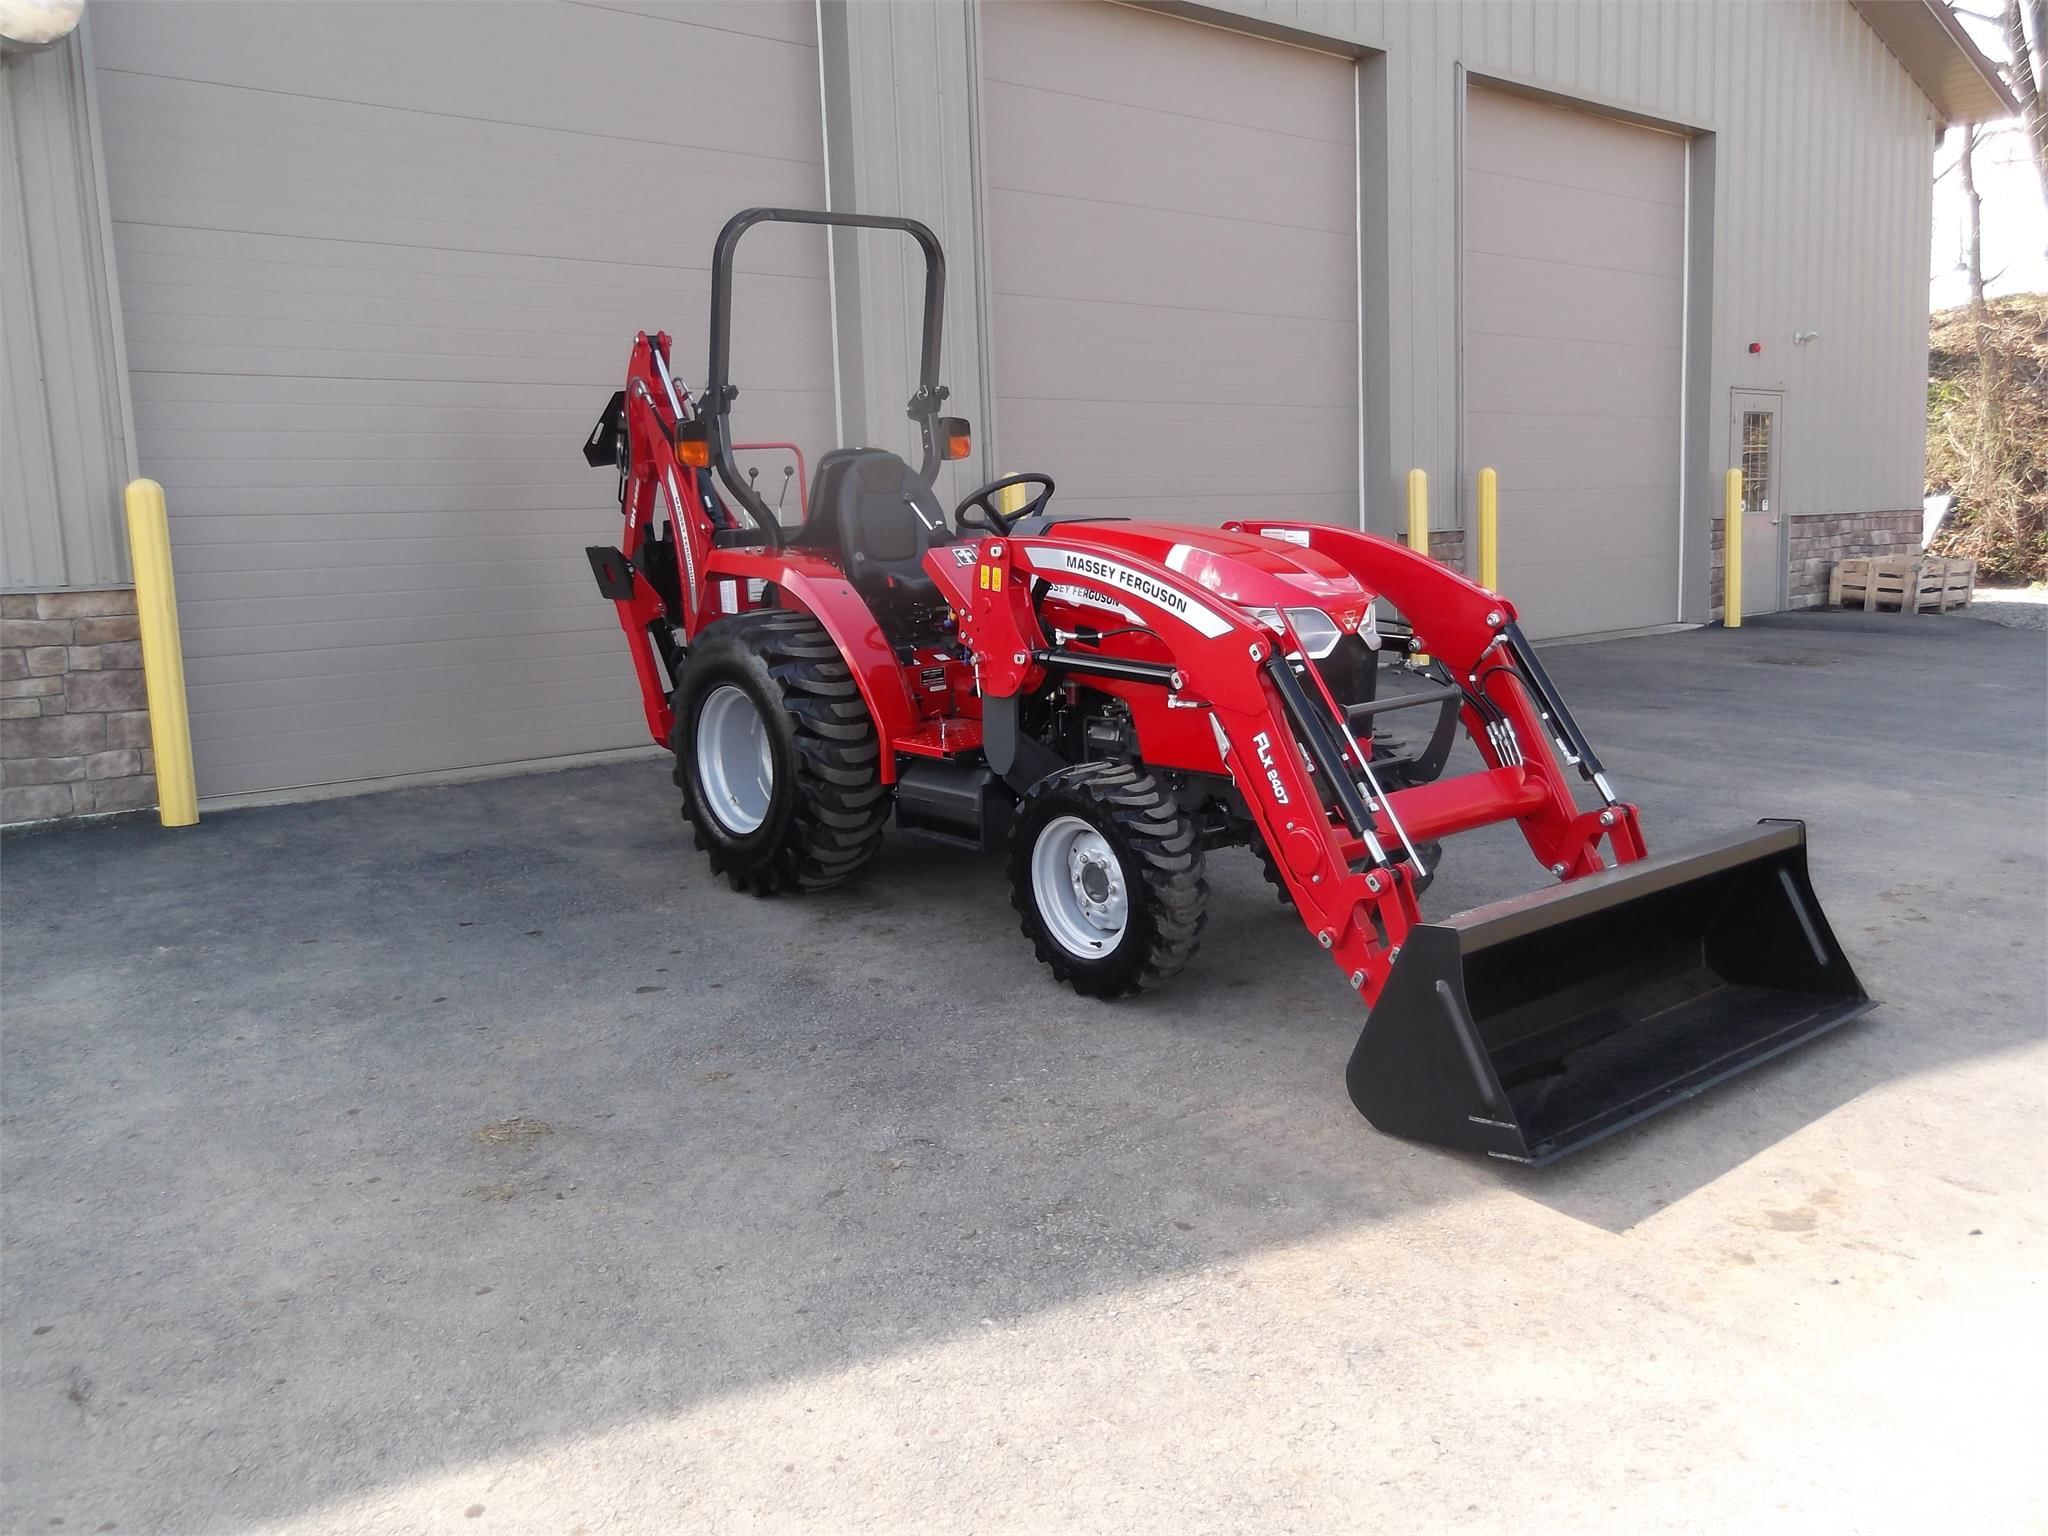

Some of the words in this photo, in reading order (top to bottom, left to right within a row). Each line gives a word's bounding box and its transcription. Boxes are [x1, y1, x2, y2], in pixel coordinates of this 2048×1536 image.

[1049, 584, 1070, 593] SSEY
[1072, 586, 1120, 607] FERGUSON
[1066, 555, 1116, 579] MASSEY
[1119, 571, 1187, 613] FERGUSON
[1266, 768, 1289, 804] 2407
